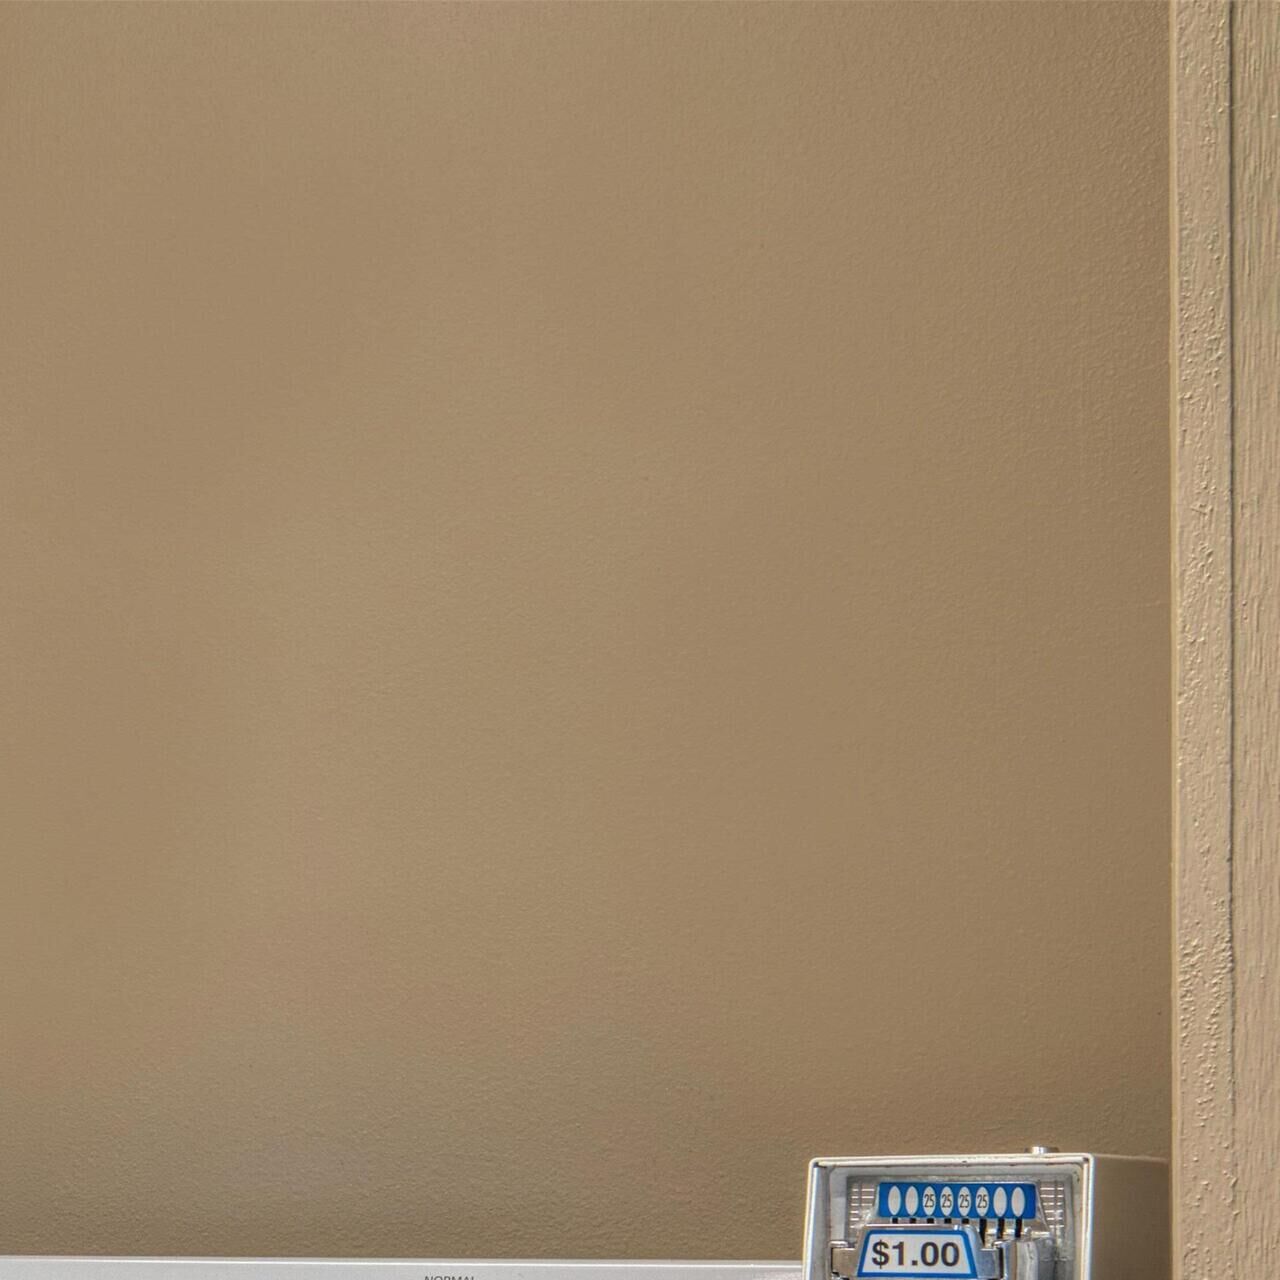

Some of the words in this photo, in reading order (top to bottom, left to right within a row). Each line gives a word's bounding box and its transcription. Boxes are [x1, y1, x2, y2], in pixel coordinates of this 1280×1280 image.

[923, 1193, 935, 1208] 25
[941, 1193, 952, 1208] 25
[959, 1194, 970, 1208] 25
[976, 1194, 988, 1209] 25
[871, 1239, 960, 1269] $1.00
